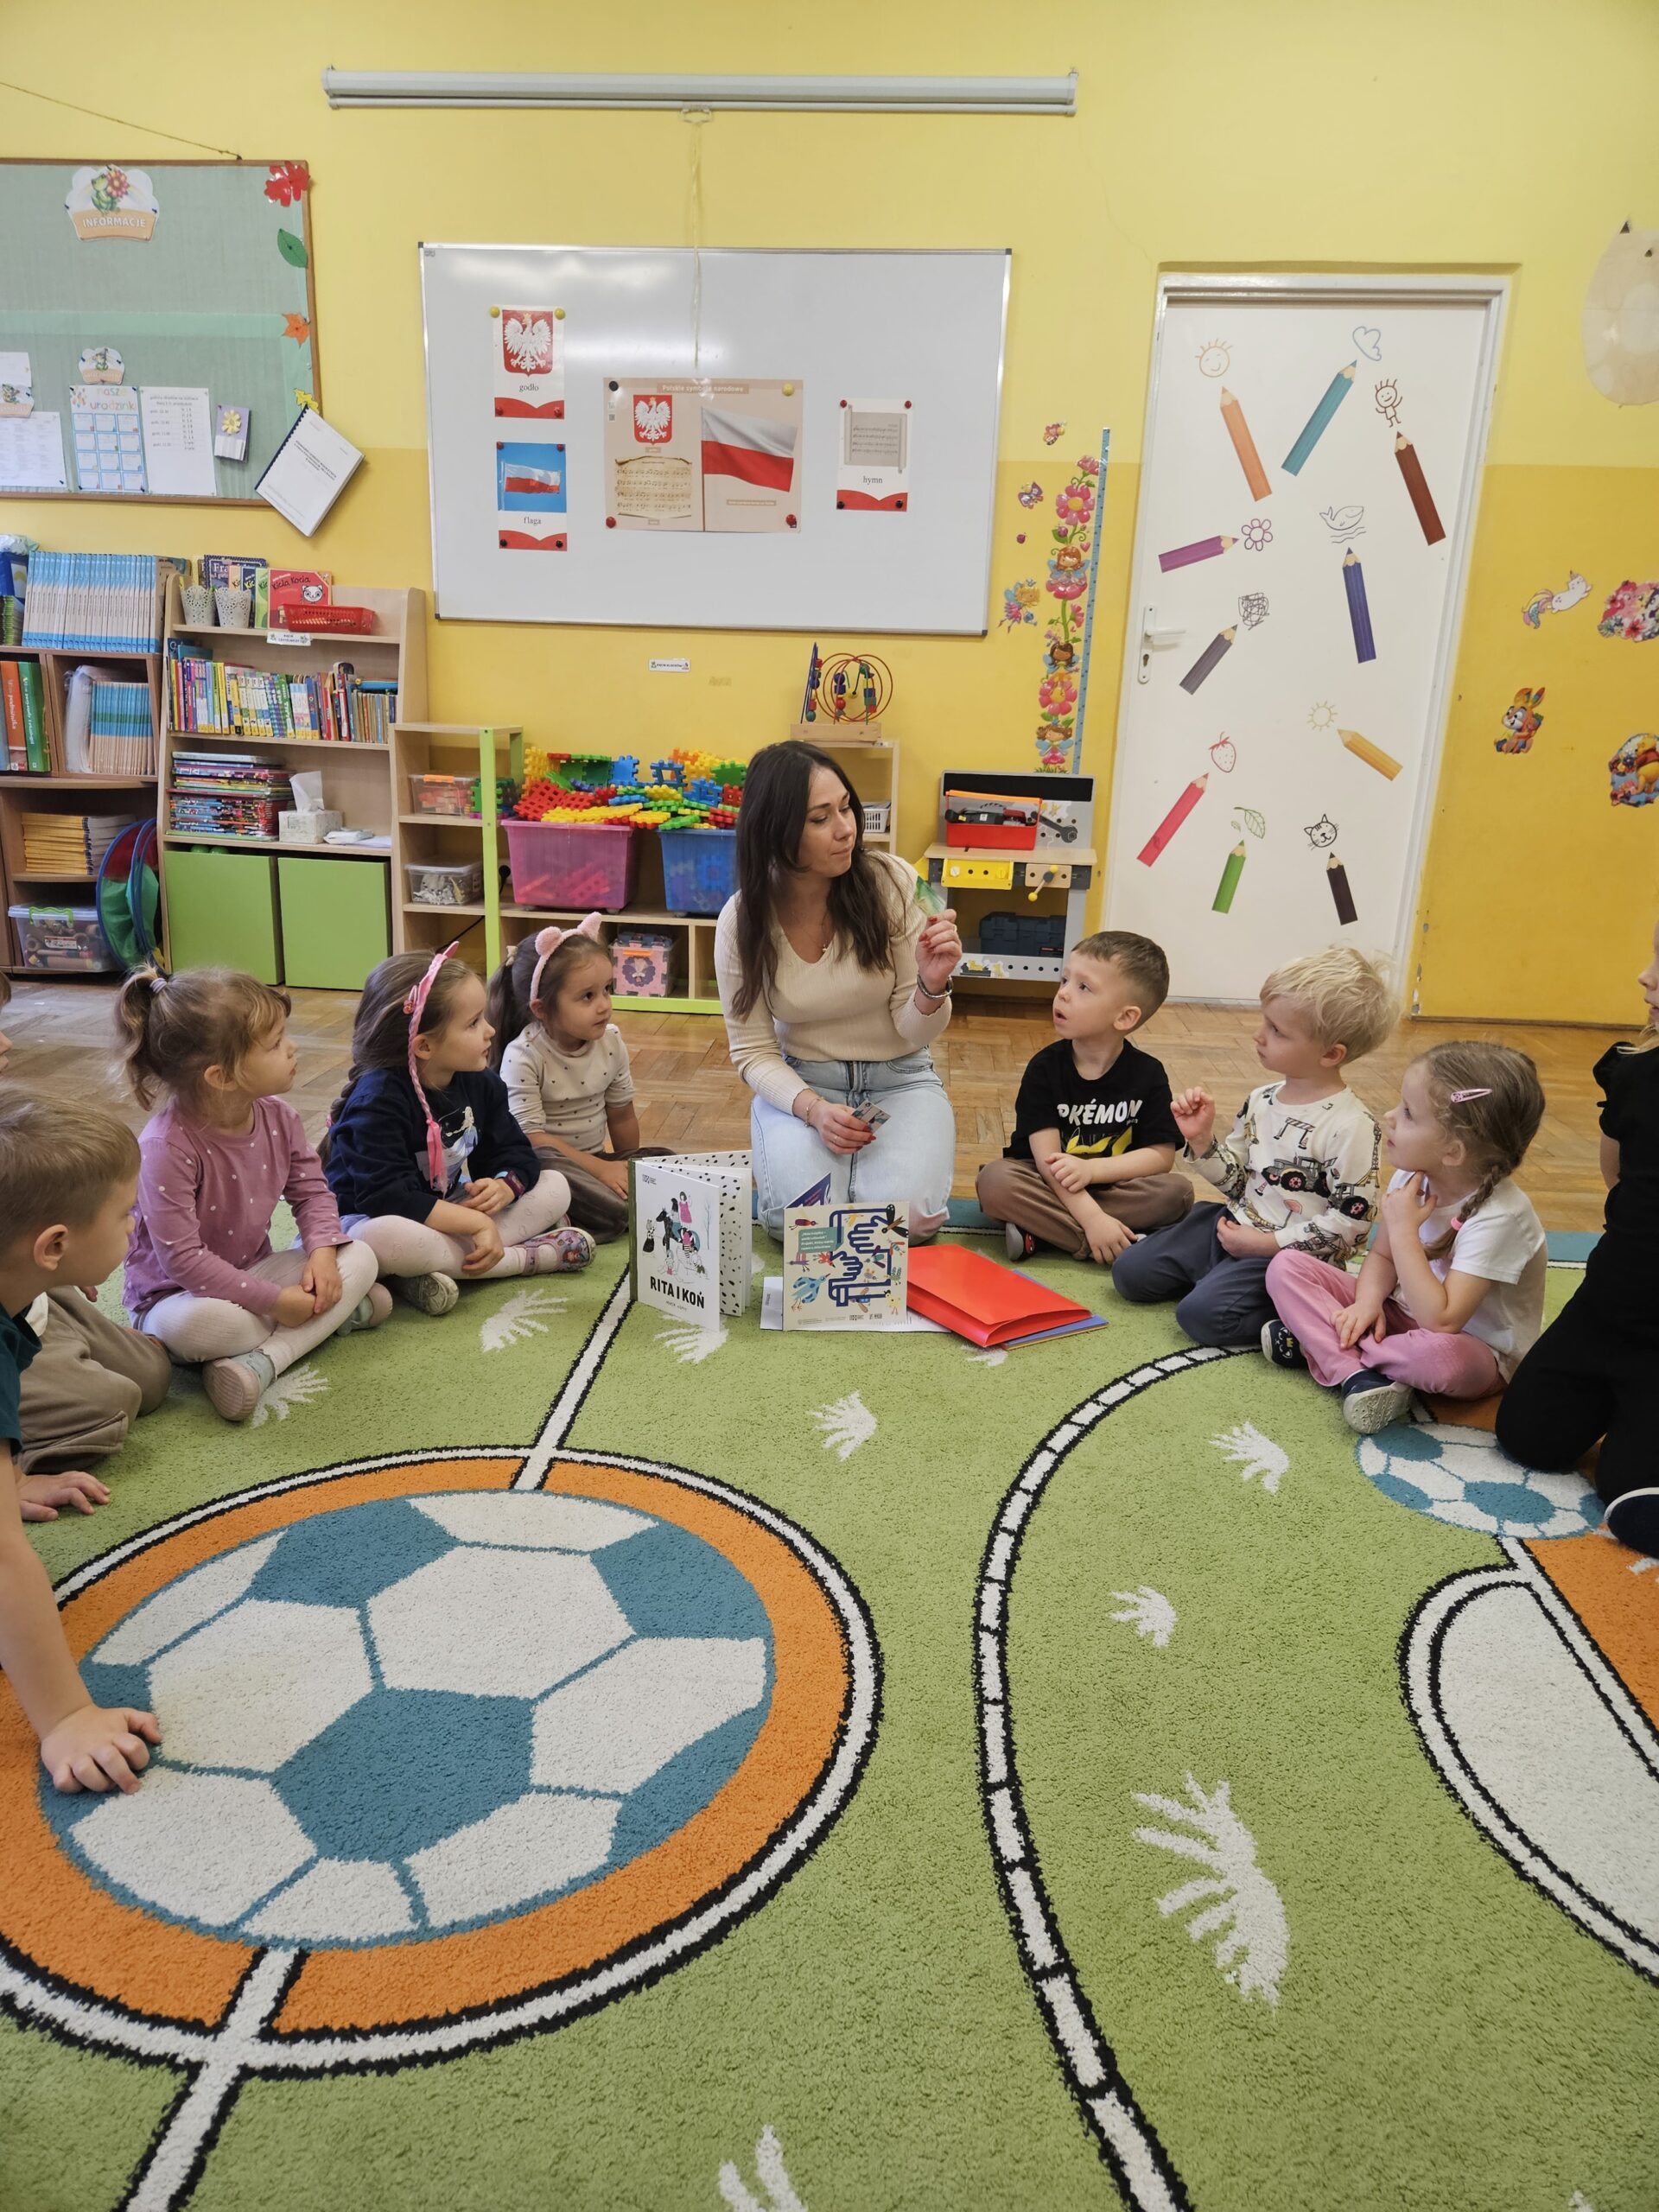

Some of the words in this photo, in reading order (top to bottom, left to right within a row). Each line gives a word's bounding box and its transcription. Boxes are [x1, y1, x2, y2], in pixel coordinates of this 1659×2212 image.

[82, 216, 146, 228] INFORMACJE
[519, 384, 539, 392] godło
[862, 475, 883, 485] hymn
[524, 516, 542, 525] flaga
[1057, 1098, 1143, 1127] PKÉMON
[650, 1275, 675, 1298] RITA
[677, 1286, 680, 1300] I
[682, 1287, 704, 1309] KOŃ
